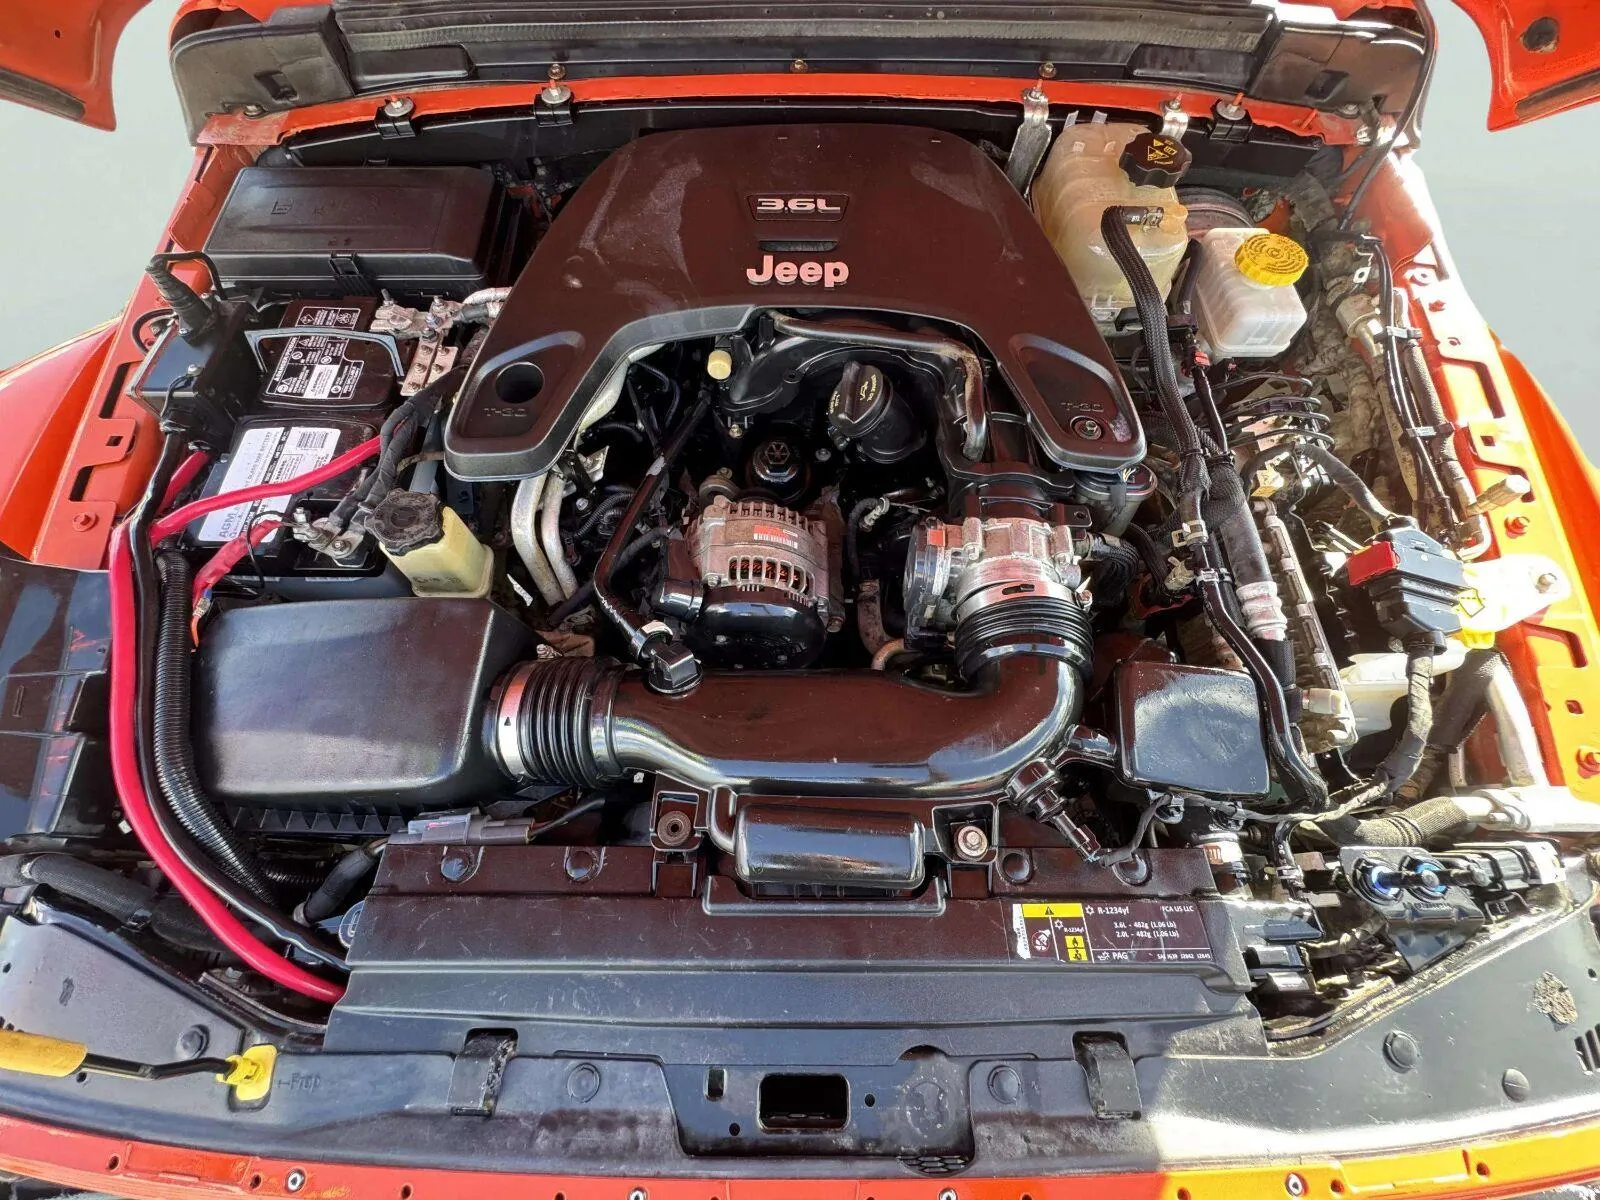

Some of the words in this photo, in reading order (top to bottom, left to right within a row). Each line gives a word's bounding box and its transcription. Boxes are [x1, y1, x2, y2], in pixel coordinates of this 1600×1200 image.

[757, 198, 840, 212] 3.6L
[746, 255, 850, 288] Jeep
[1097, 906, 1129, 916] R-1234yf
[1112, 951, 1129, 960] PAG
[290, 1072, 321, 1094] Prop
